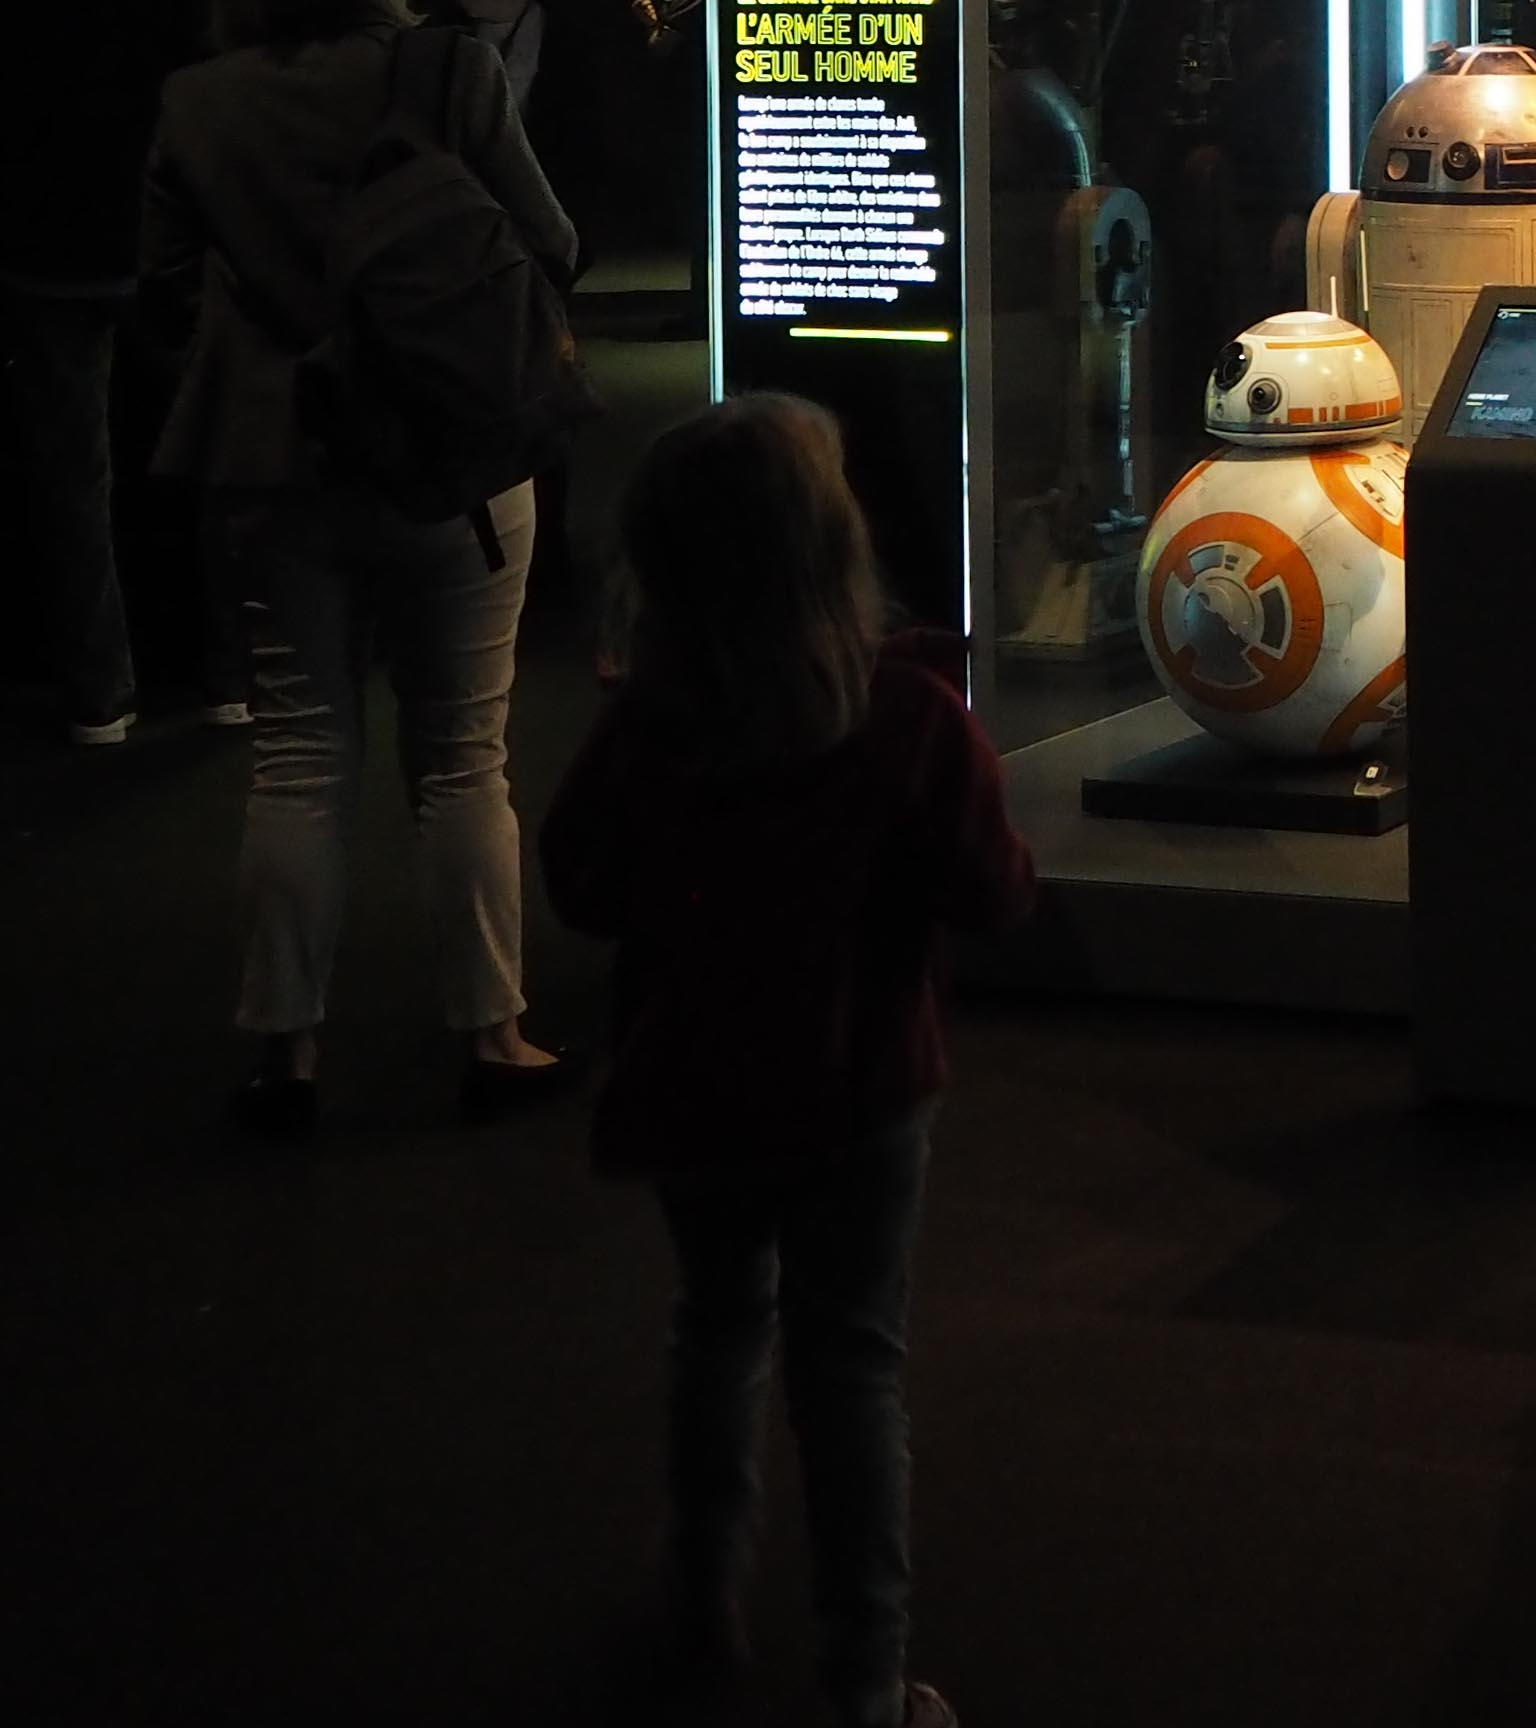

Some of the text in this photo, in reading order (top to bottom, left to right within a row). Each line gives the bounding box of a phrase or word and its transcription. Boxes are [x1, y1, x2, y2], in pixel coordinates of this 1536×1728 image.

[859, 13, 923, 45] D'UN
[735, 49, 917, 82] SEUL HOMME
